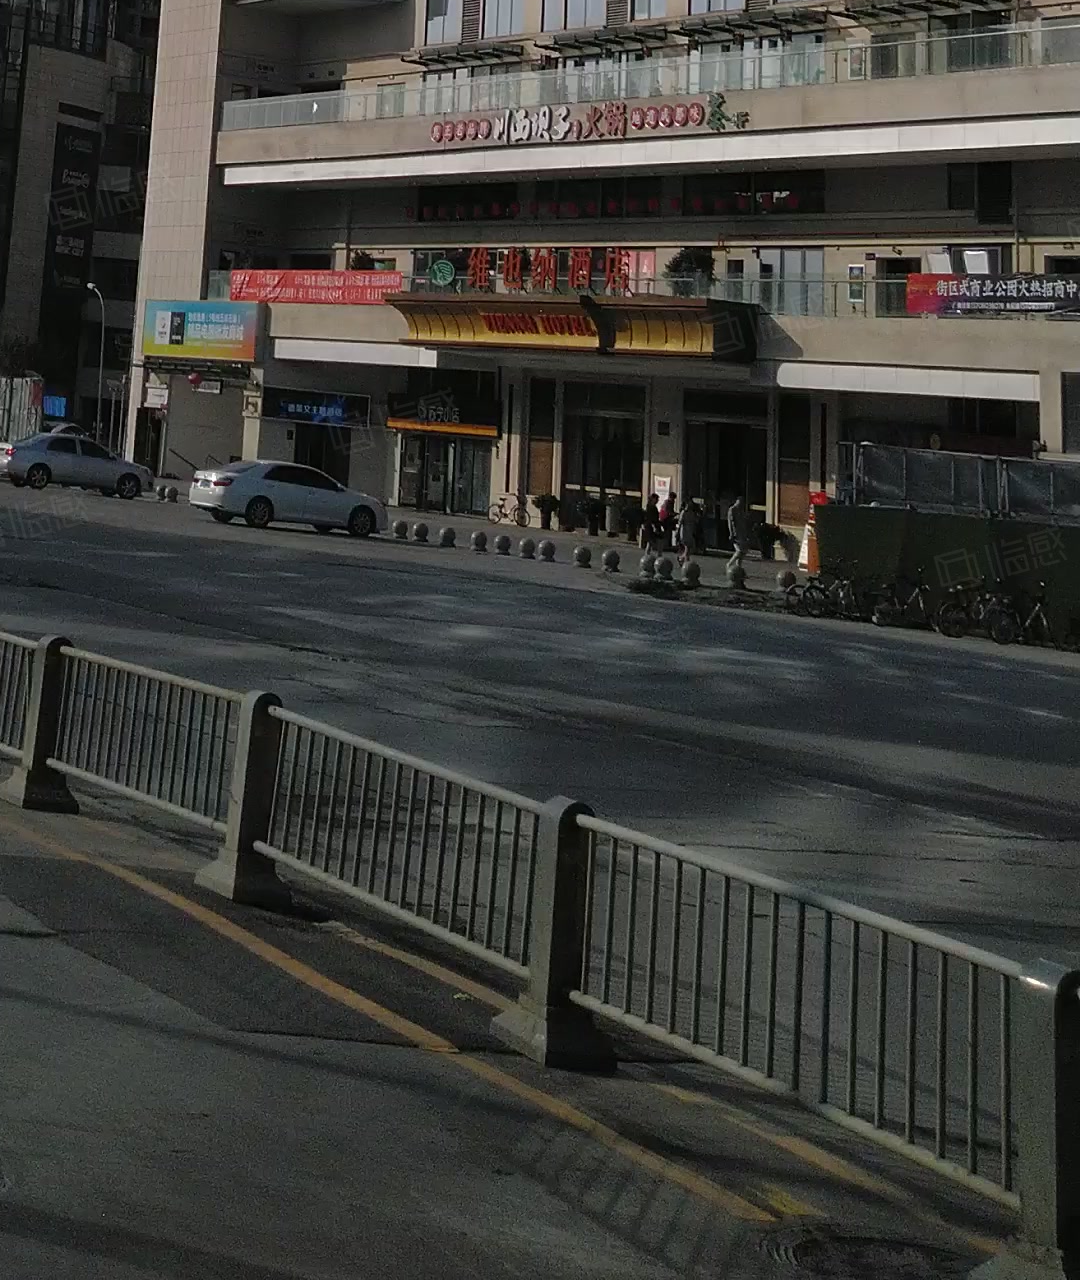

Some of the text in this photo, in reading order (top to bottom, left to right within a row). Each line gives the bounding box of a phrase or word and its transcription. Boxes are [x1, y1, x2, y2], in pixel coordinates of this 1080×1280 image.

[582, 100, 627, 140] 火锅
[468, 247, 631, 290] 维也纳酒店
